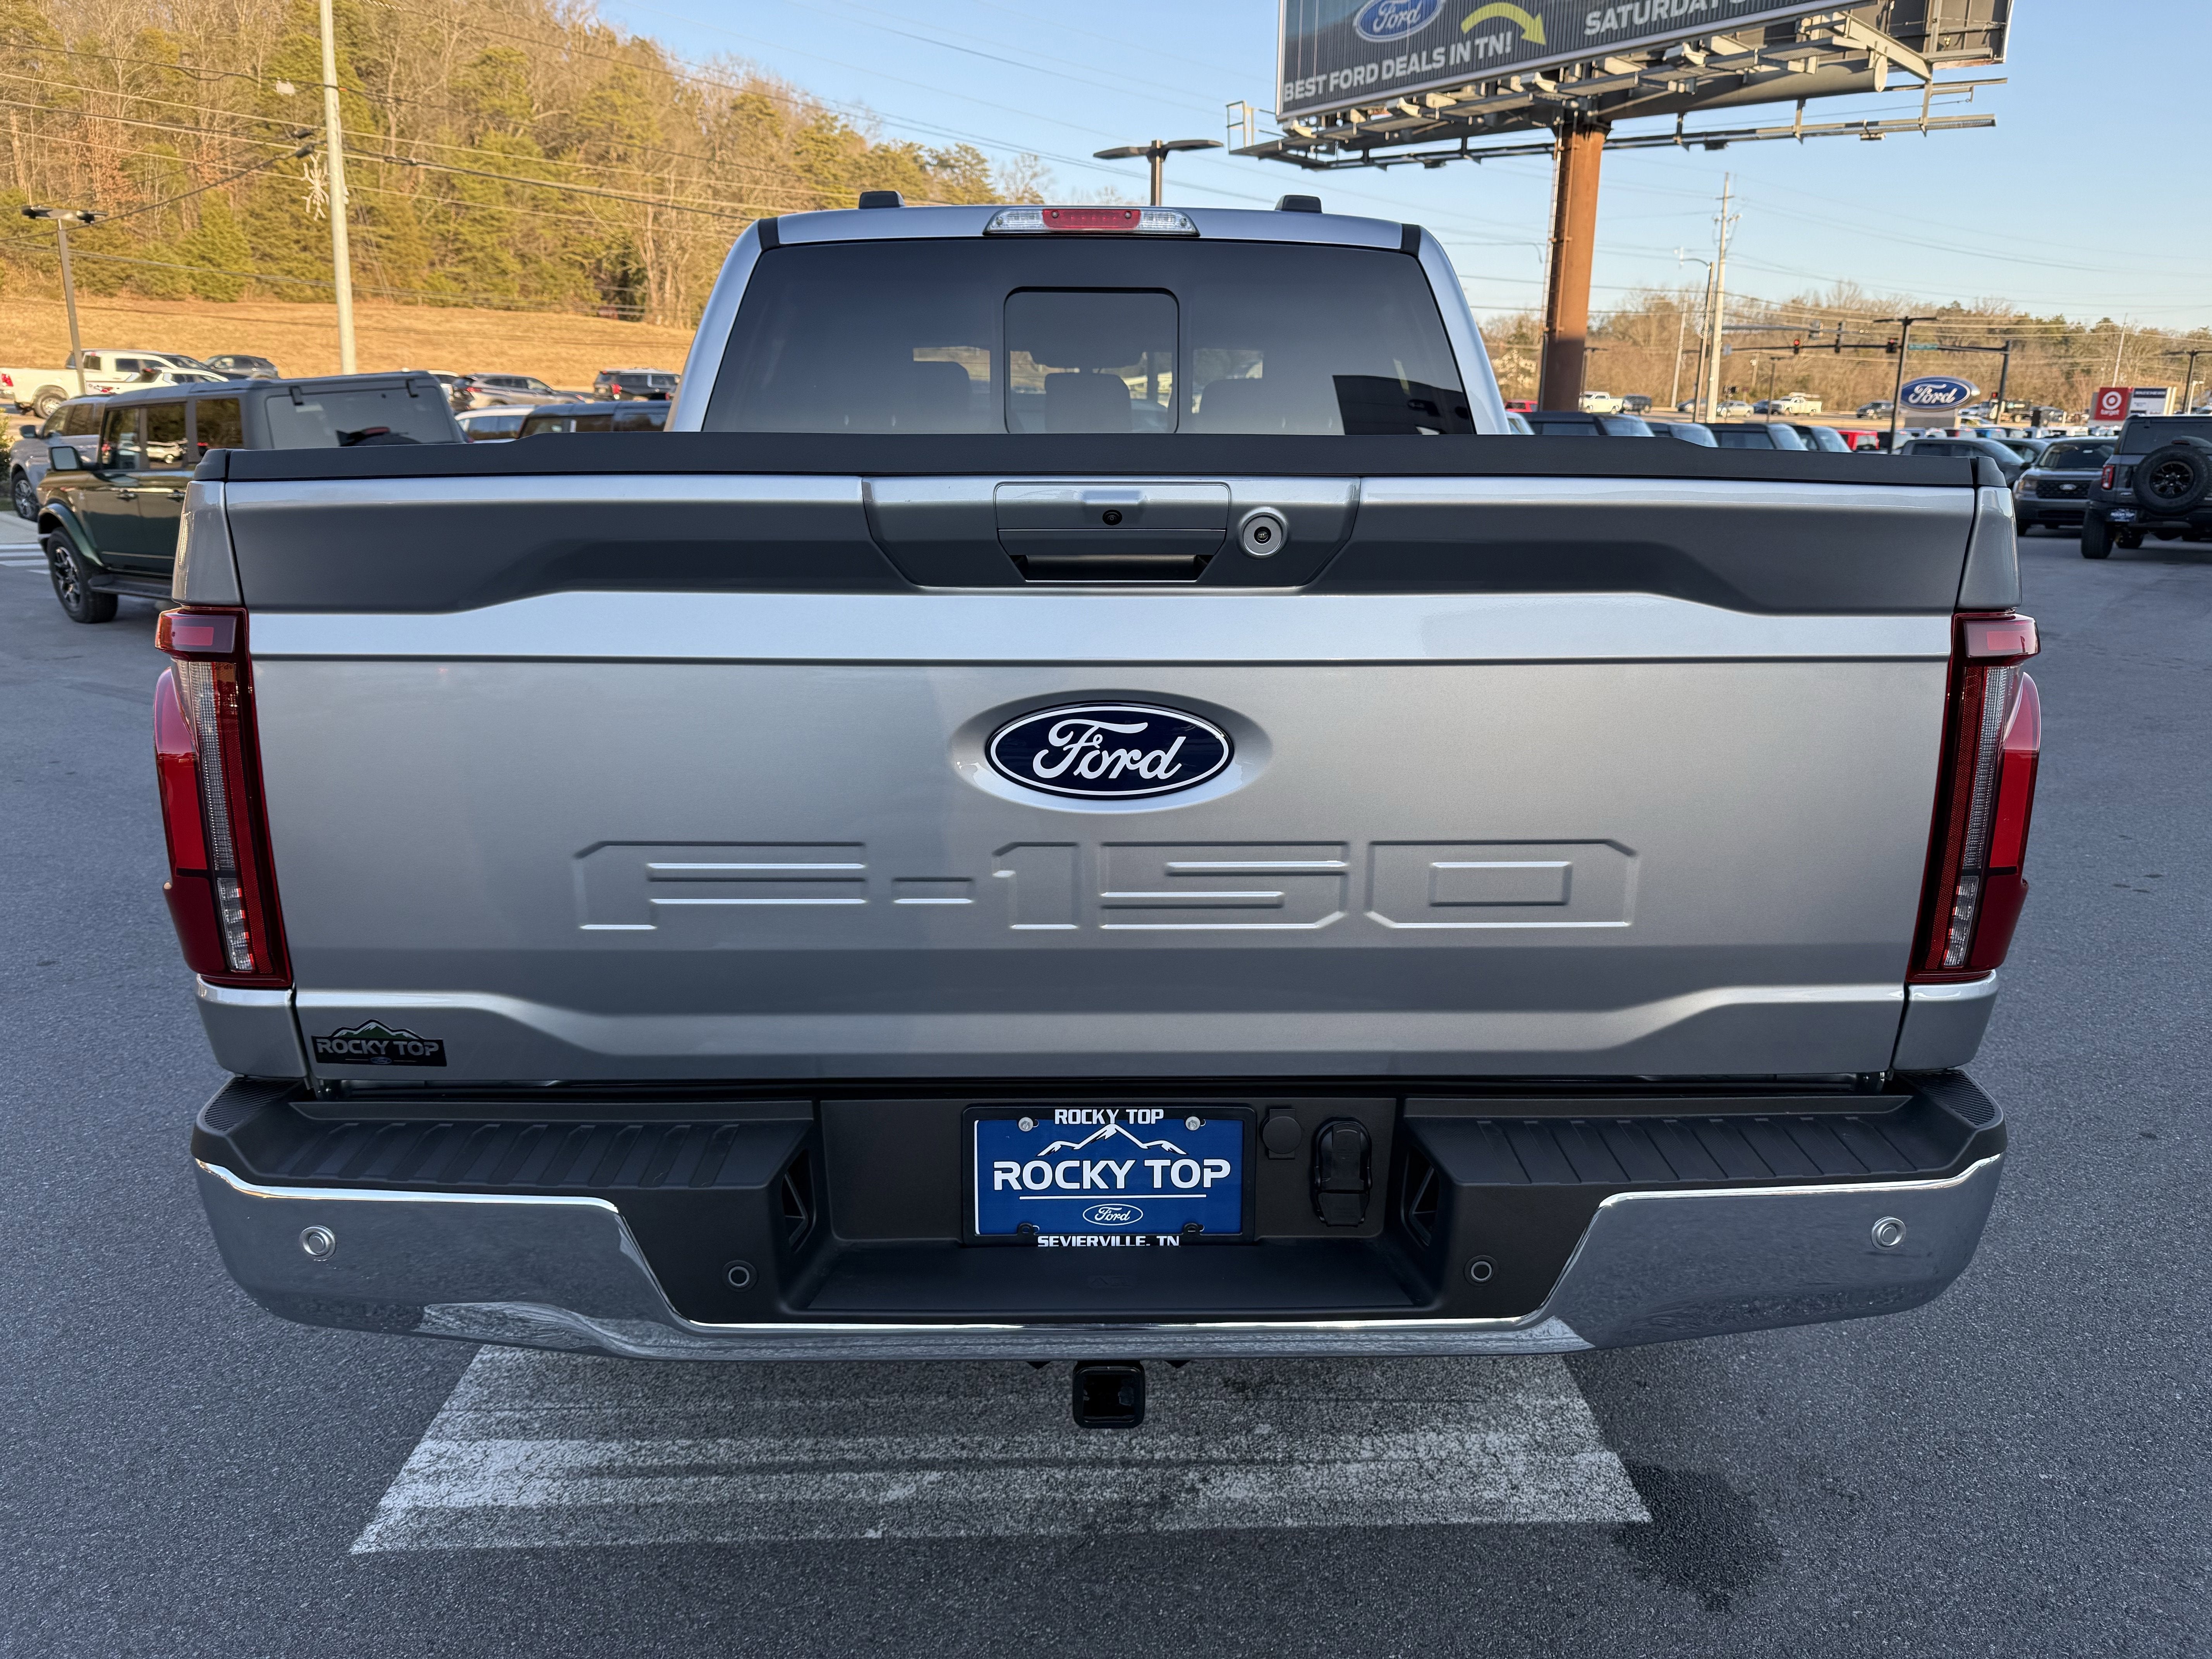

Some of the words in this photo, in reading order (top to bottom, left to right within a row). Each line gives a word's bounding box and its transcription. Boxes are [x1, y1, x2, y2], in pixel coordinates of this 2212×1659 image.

[1373, 0, 1422, 33] Ford
[1283, 74, 1327, 102] BEST
[1329, 63, 1379, 93] FORD
[1381, 46, 1445, 81] DEALS
[1449, 42, 1471, 66] IN
[1474, 30, 1512, 59] TN!
[1908, 383, 1958, 404] Ford
[1033, 719, 1186, 779] Ford
[574, 838, 1641, 929] F-150
[316, 1039, 390, 1054] ROCKY
[393, 1041, 439, 1056] TOP
[1054, 1109, 1119, 1125] ROCKY
[1126, 1109, 1164, 1125] TOP
[994, 1159, 1135, 1190] ROCKY
[1144, 1159, 1231, 1188] TOP
[1094, 1207, 1131, 1221] Ford
[1156, 1235, 1180, 1246] TN
